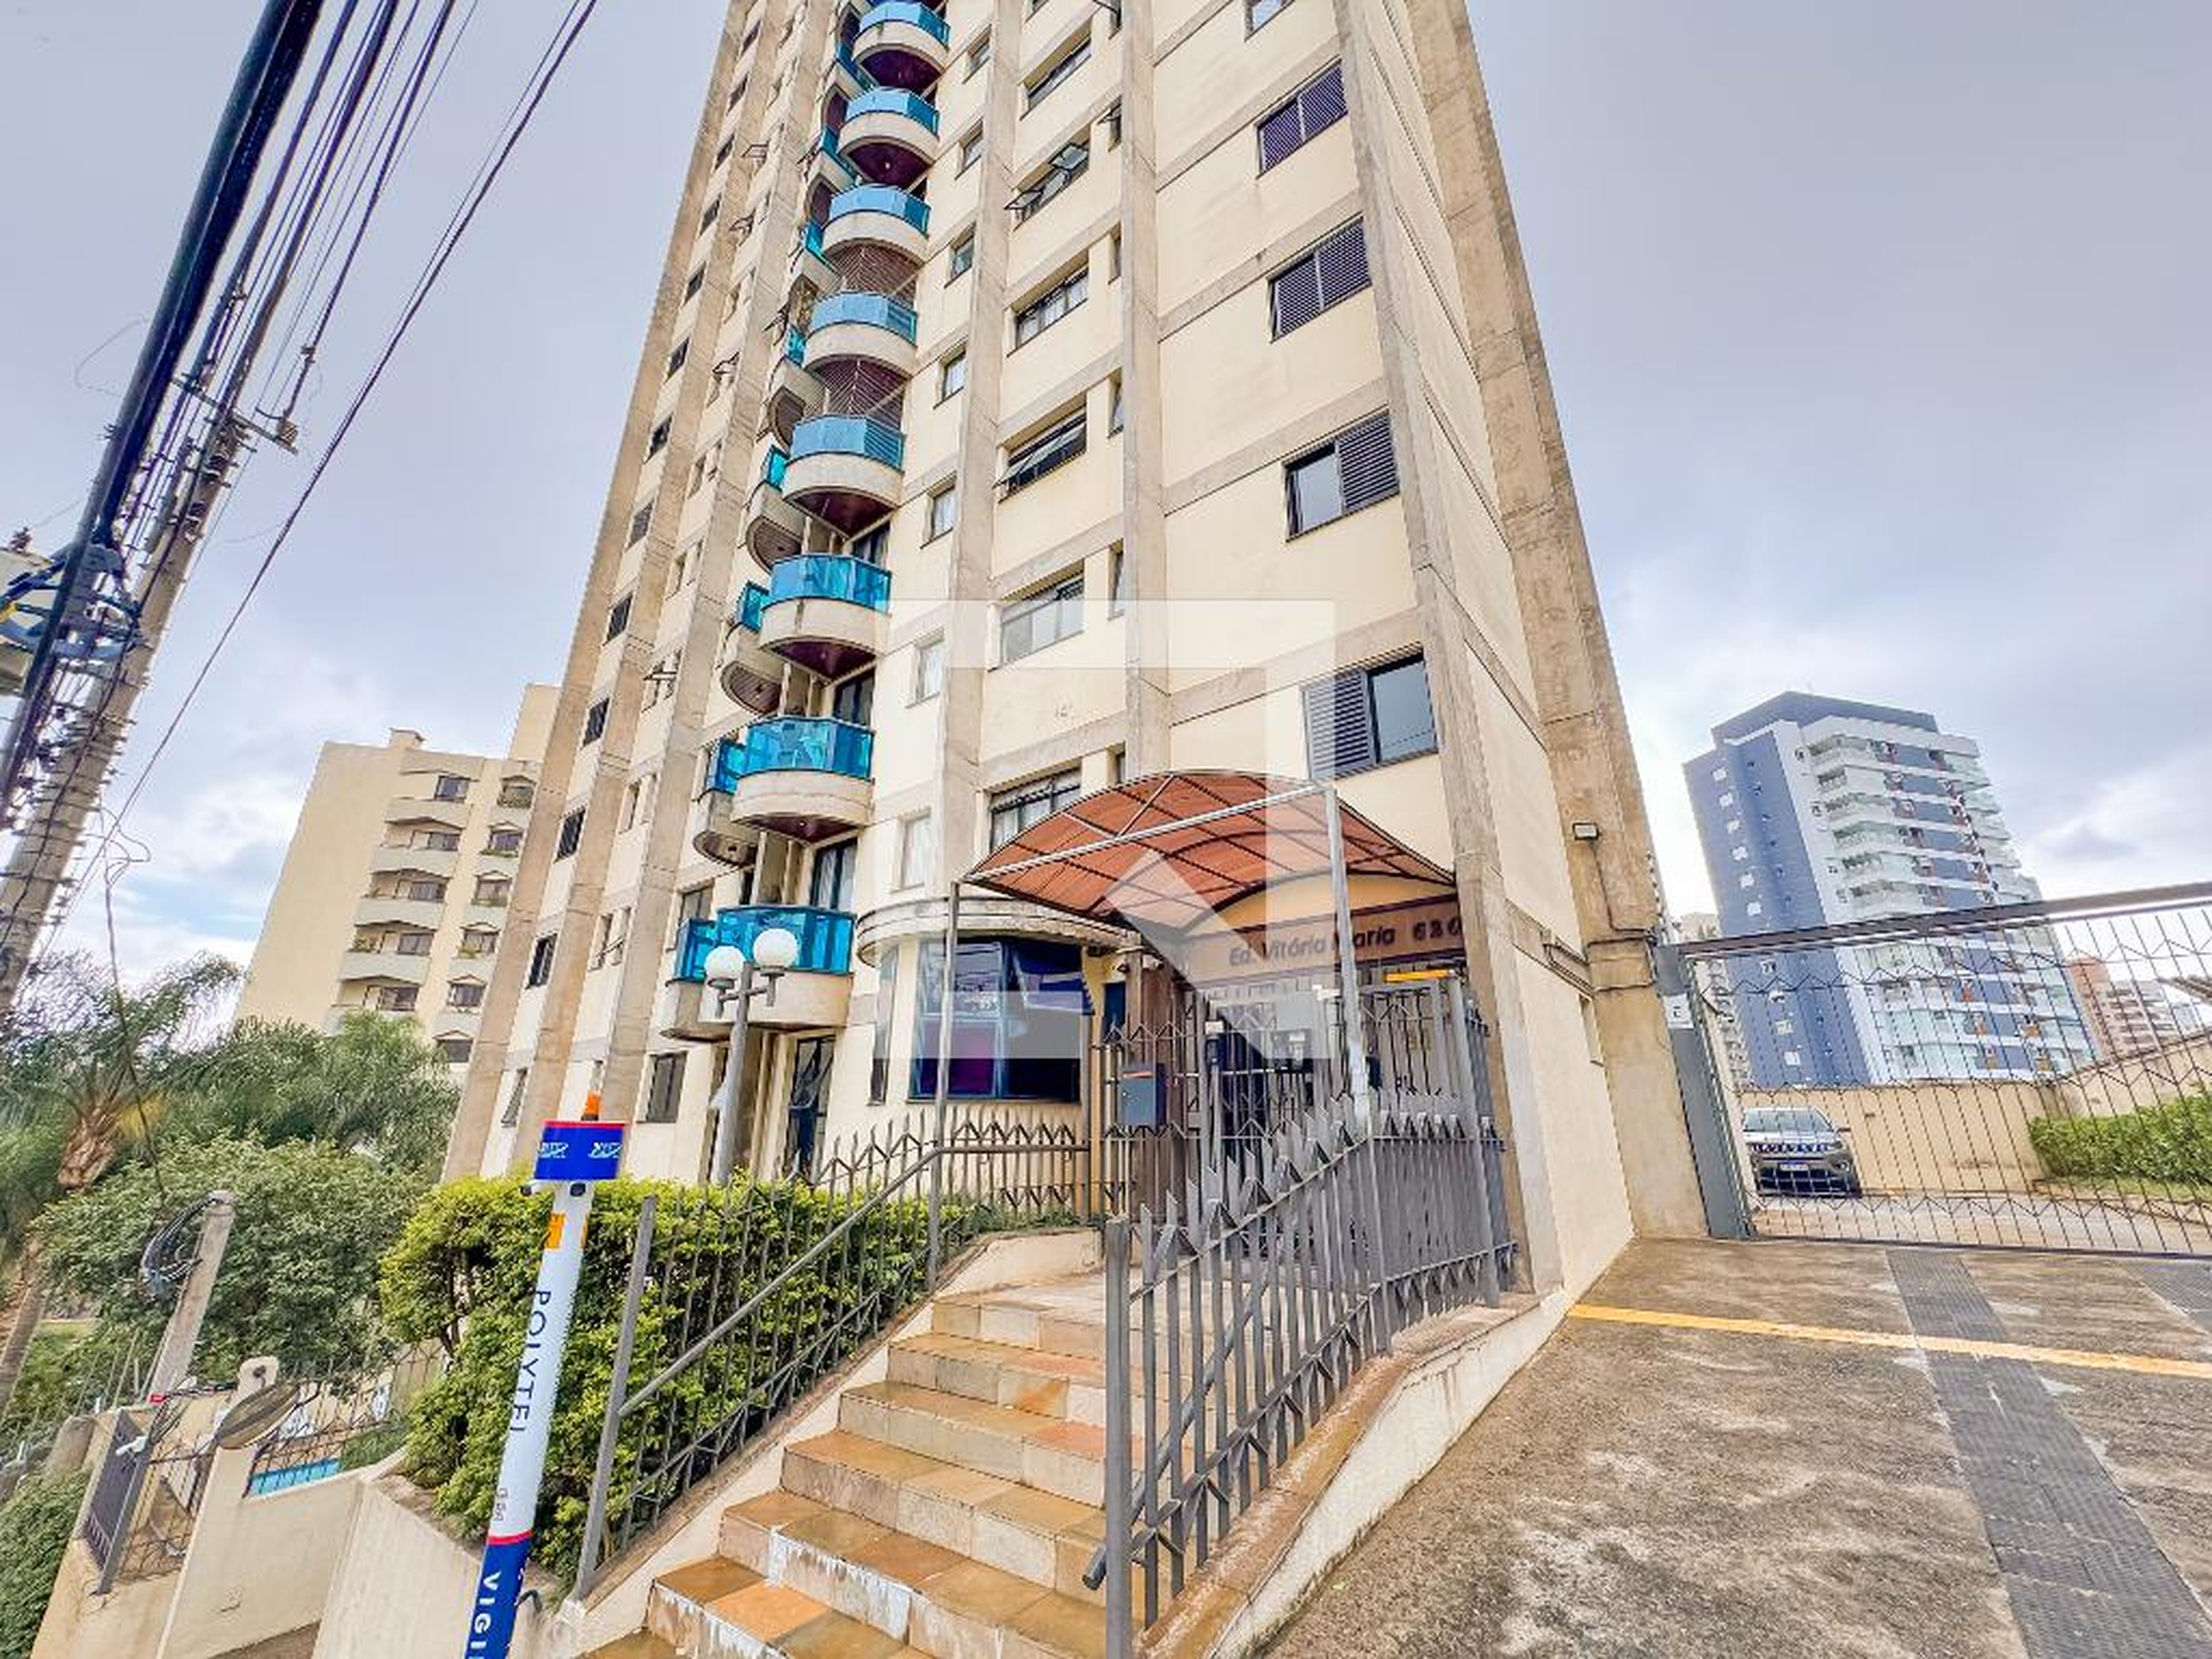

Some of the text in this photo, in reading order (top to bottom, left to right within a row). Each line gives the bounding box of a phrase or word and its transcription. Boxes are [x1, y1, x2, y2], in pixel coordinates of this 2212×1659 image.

[1229, 948, 1256, 967] Ed.
[1262, 937, 1327, 961] Vitória
[467, 1570, 502, 1659] VIGI
